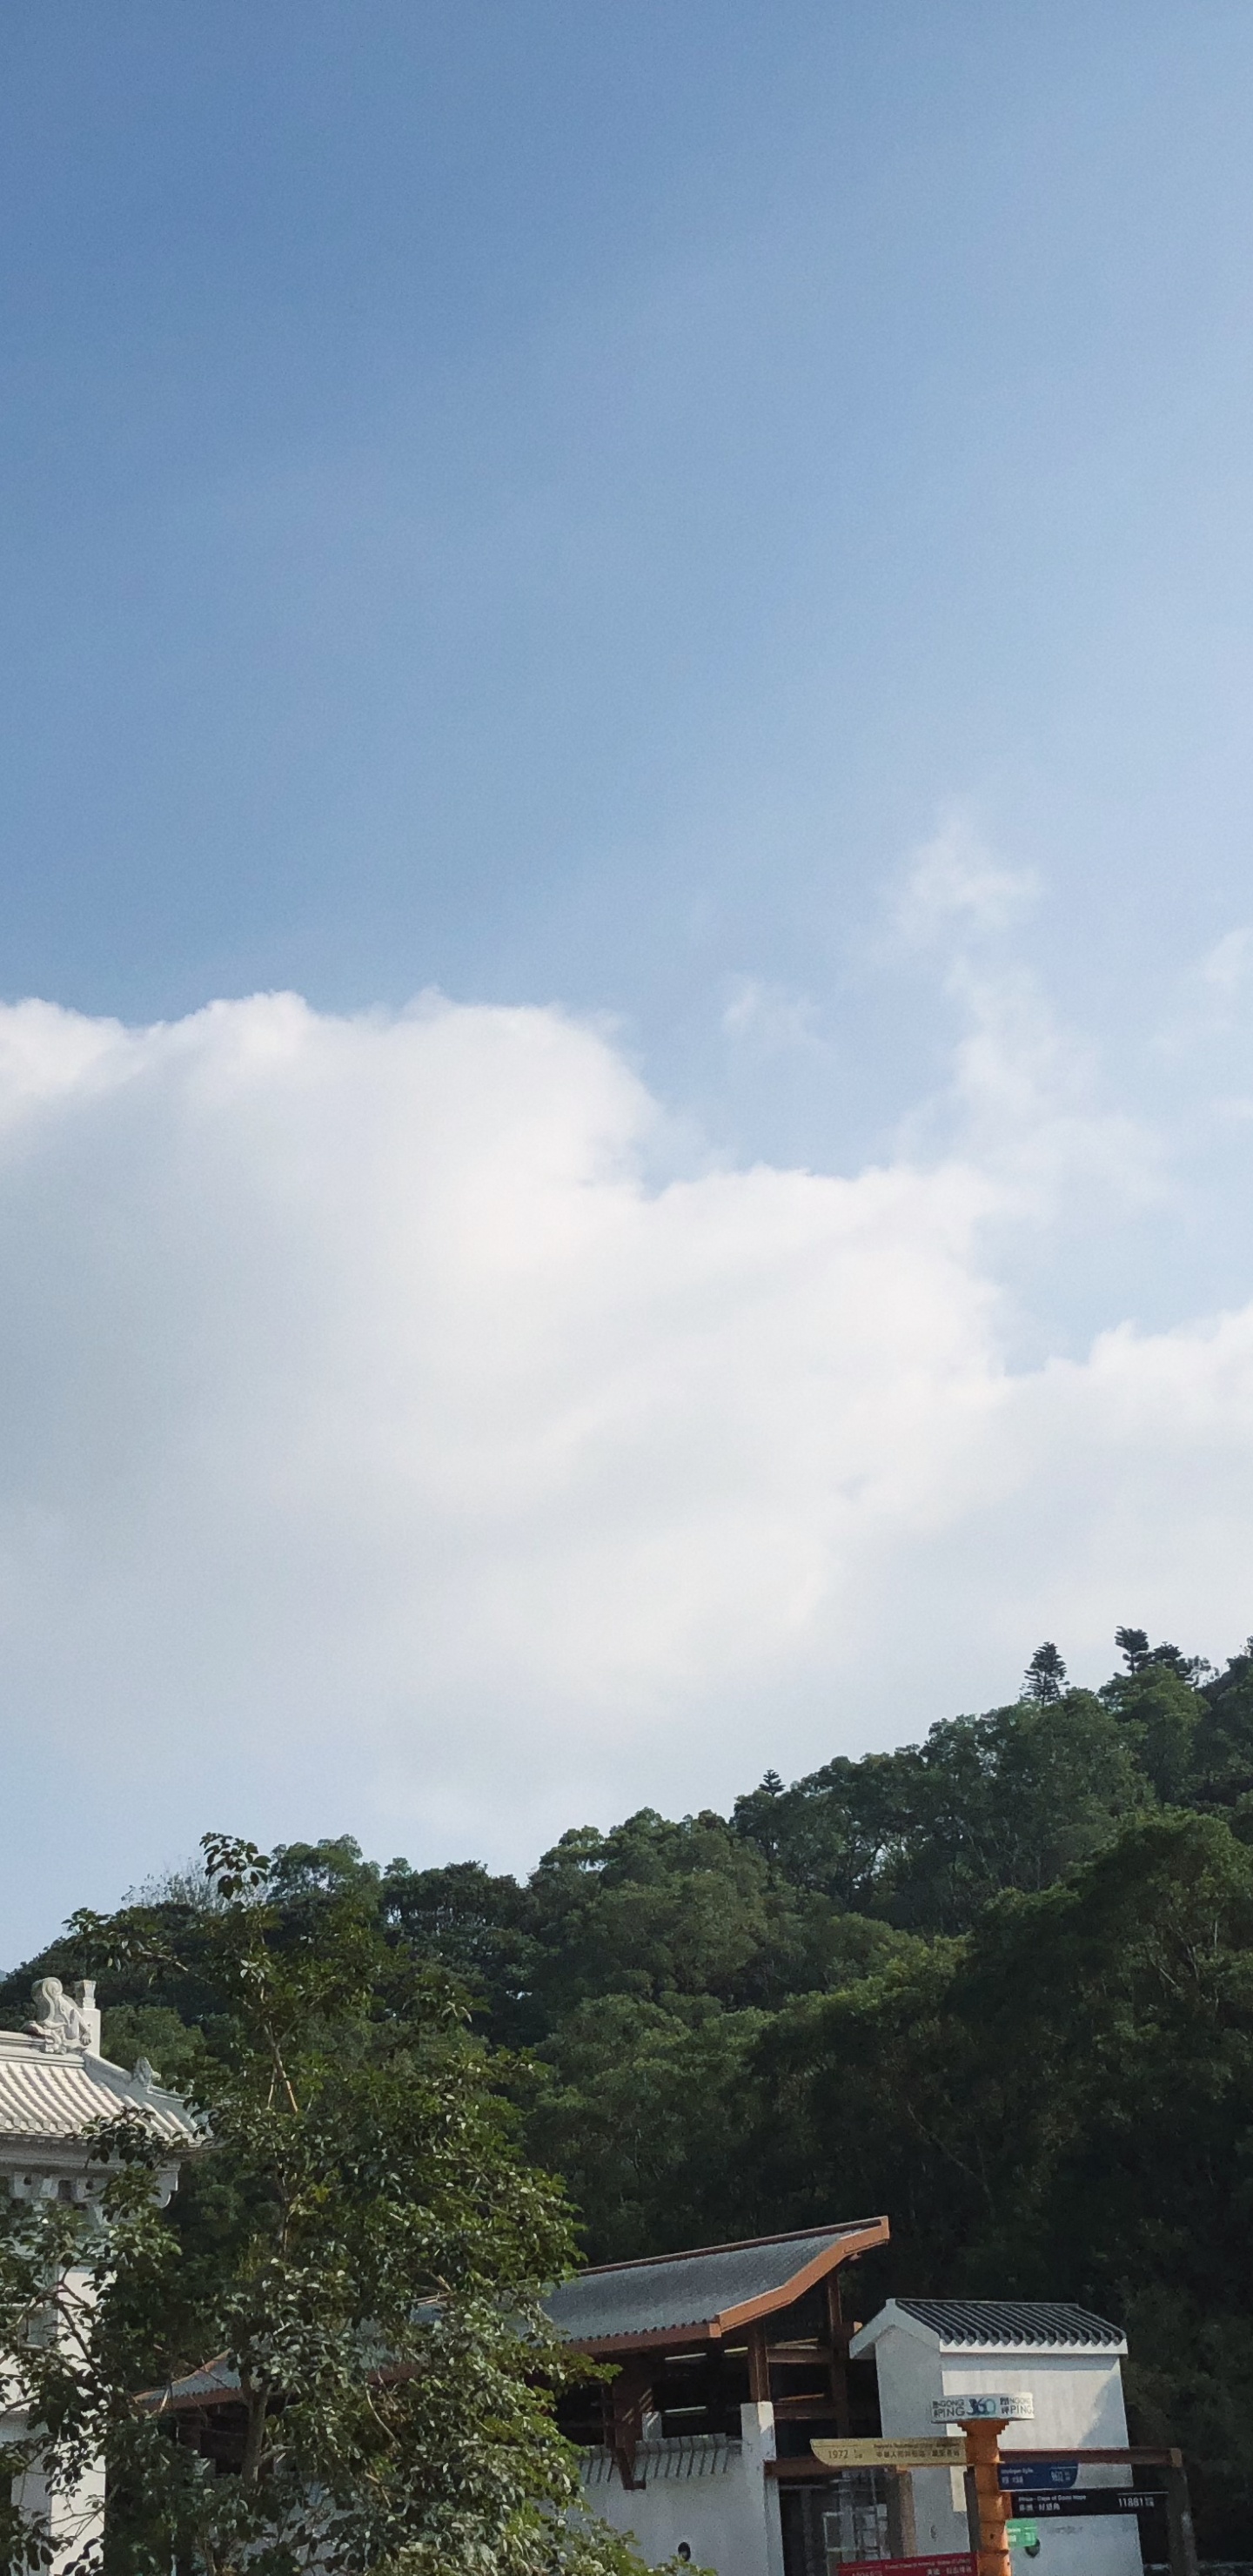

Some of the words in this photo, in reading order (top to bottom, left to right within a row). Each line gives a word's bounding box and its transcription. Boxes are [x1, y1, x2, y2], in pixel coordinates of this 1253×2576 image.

[967, 2398, 996, 2416] 360
[1010, 2405, 1033, 2414] PING
[828, 2449, 848, 2459] 1972
